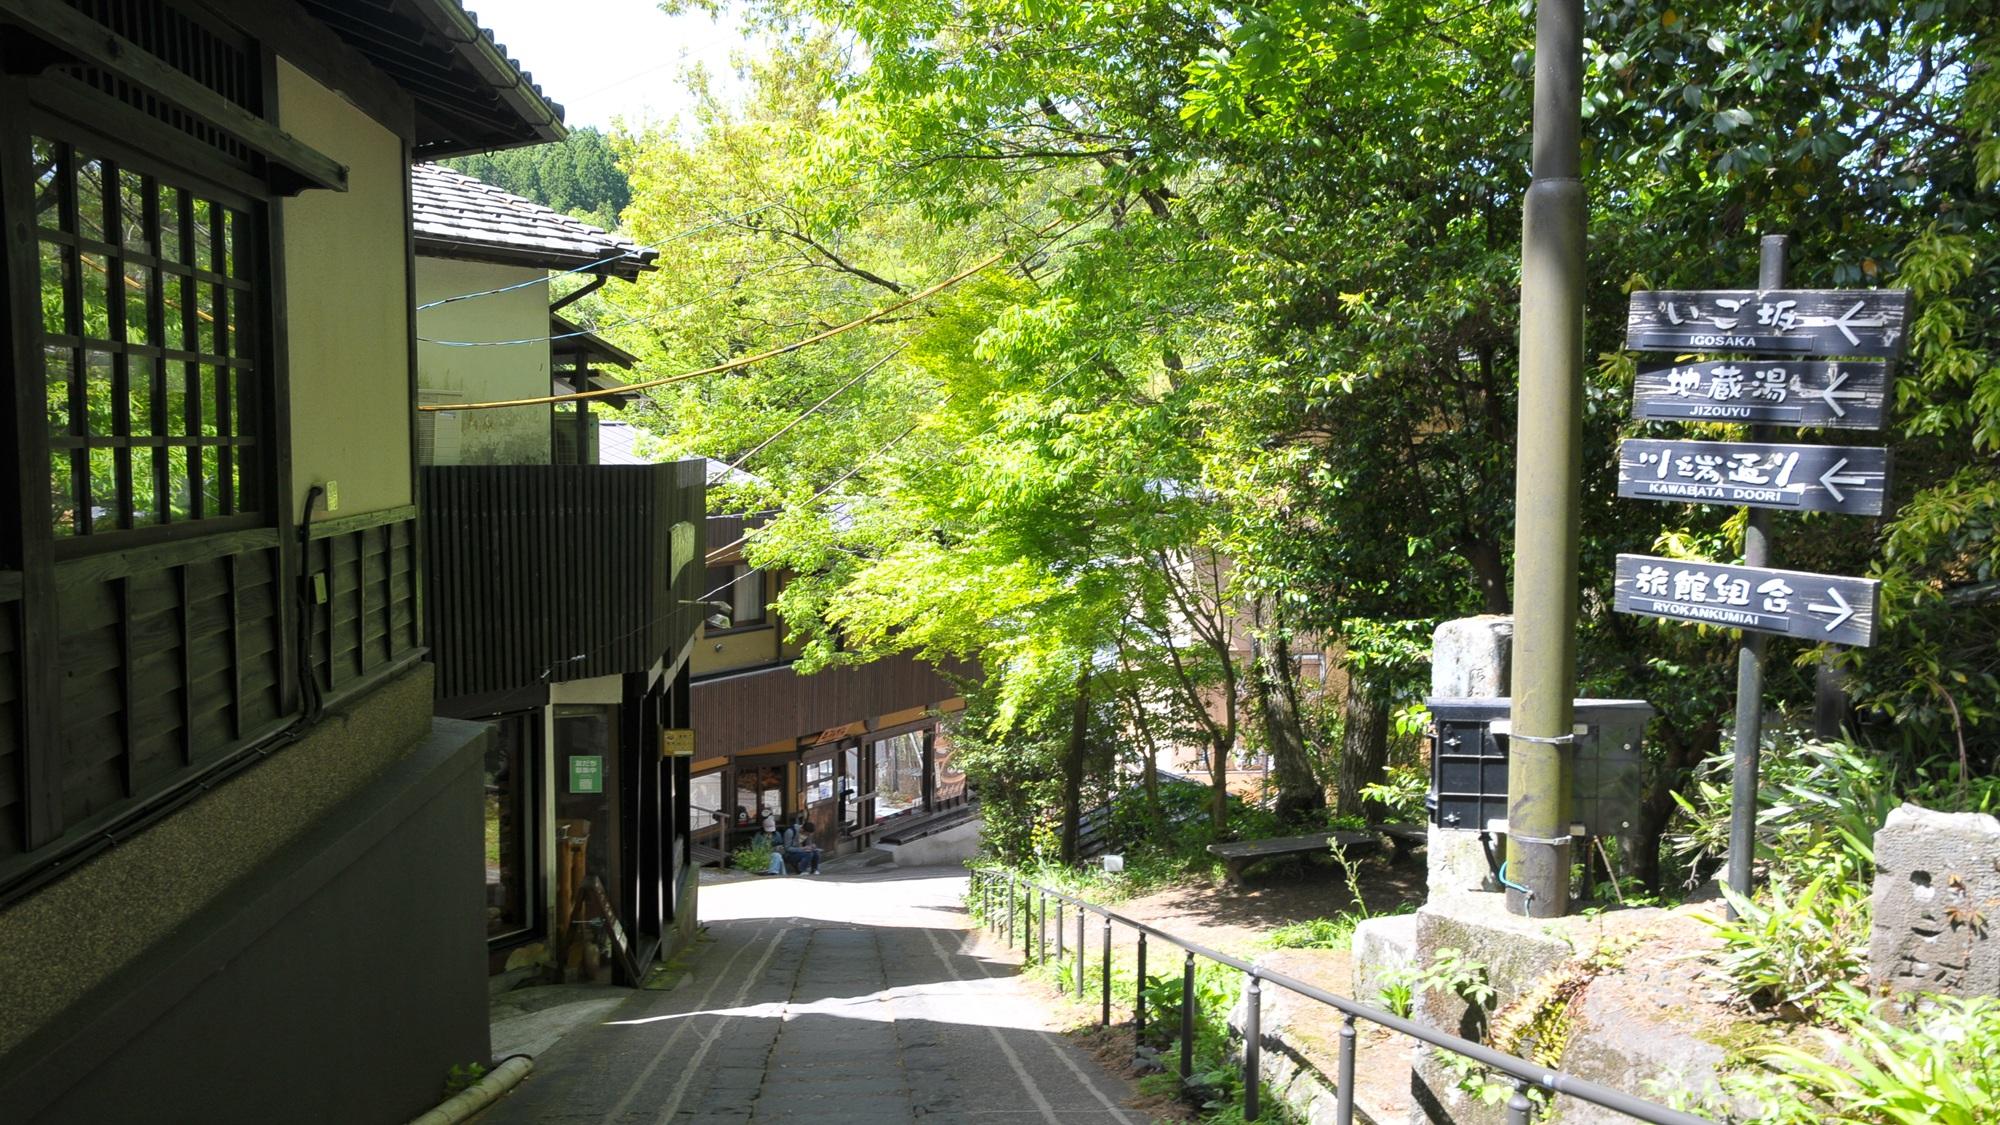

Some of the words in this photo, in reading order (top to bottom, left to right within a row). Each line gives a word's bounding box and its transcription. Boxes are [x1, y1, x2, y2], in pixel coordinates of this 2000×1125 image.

[1667, 299, 1798, 331] いご坂
[1690, 335, 1757, 348] IGOSAKA
[1667, 366, 1787, 403] 地蔵湯
[1689, 405, 1751, 418] JIZOUYU
[1639, 449, 1800, 487] 川端通り
[1649, 482, 1725, 499] KAWABATA
[1733, 489, 1782, 503] DOORI
[1635, 565, 1793, 613] 旅館組合
[1652, 602, 1760, 626] RYOKANKUMIAI
